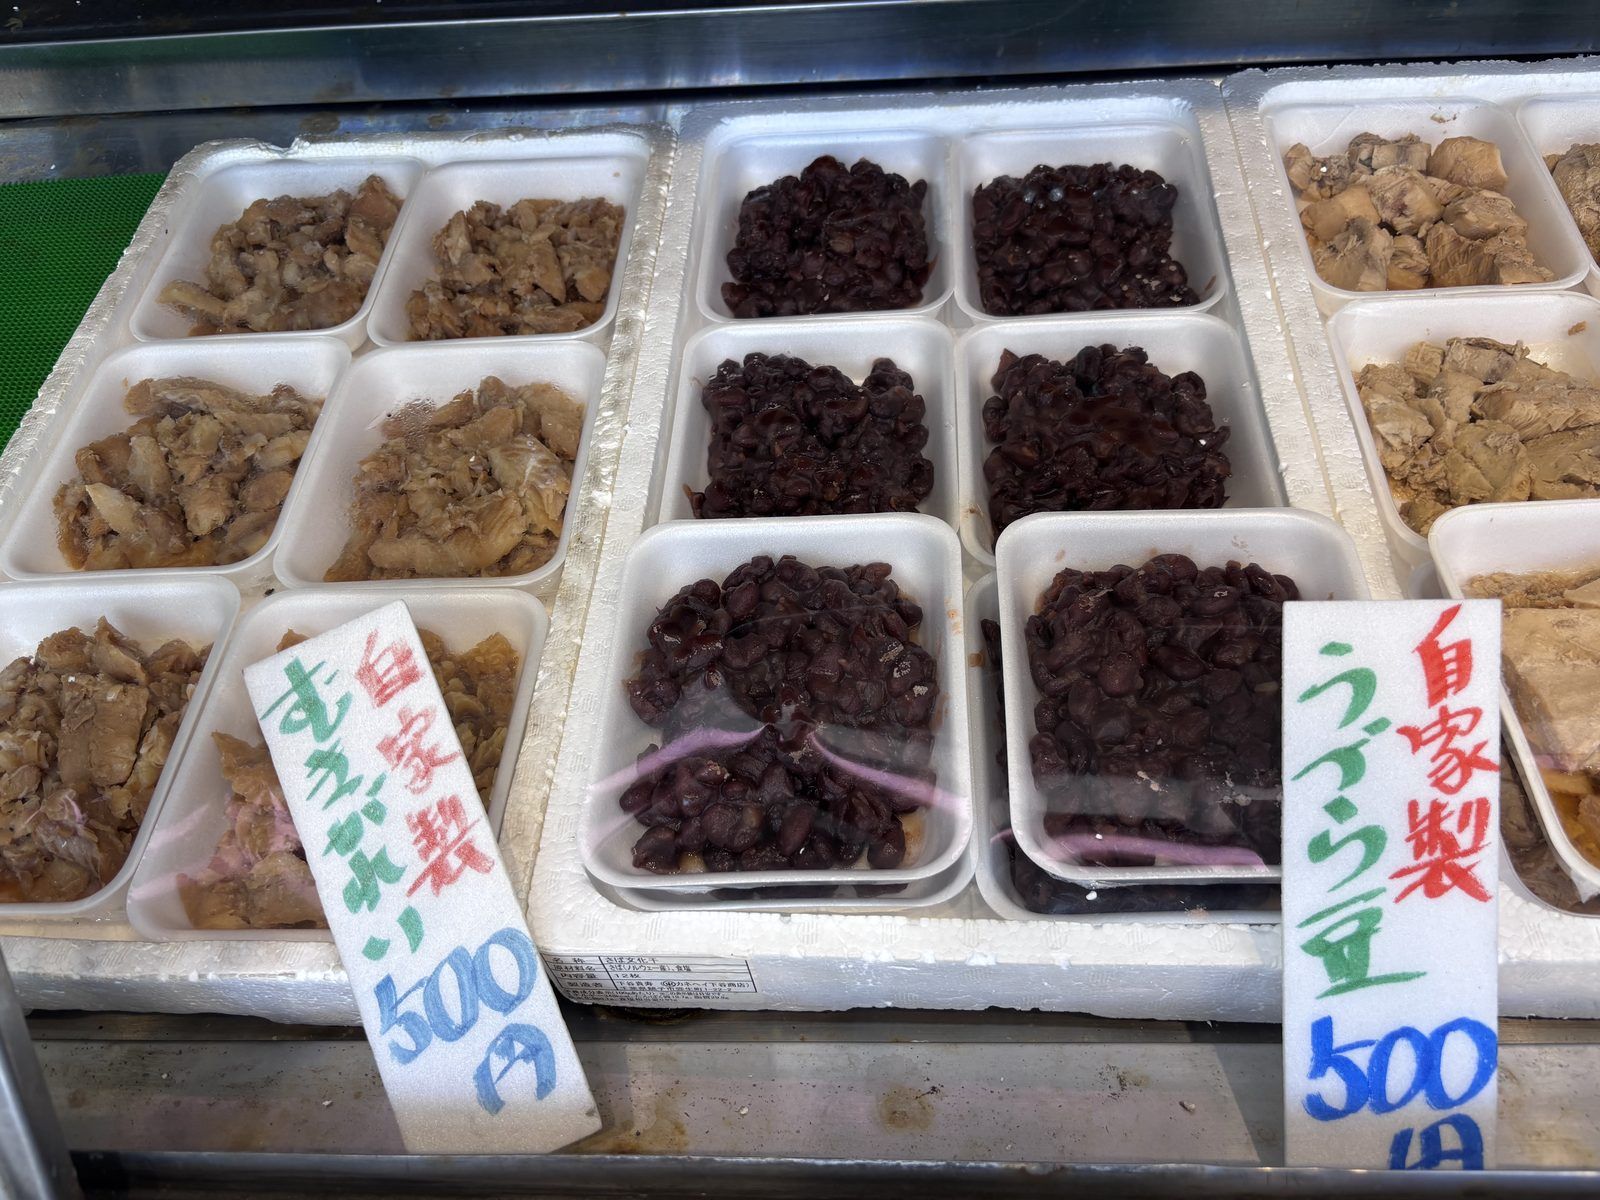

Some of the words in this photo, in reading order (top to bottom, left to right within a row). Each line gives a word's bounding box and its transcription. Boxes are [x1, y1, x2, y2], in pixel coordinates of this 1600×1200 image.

[260, 656, 423, 960] むきがれい
[355, 628, 494, 897] 自家製
[1389, 602, 1501, 905] 自家製
[374, 926, 538, 1065] 500
[473, 1022, 556, 1116] 円
[1303, 1015, 1498, 1121] 500
